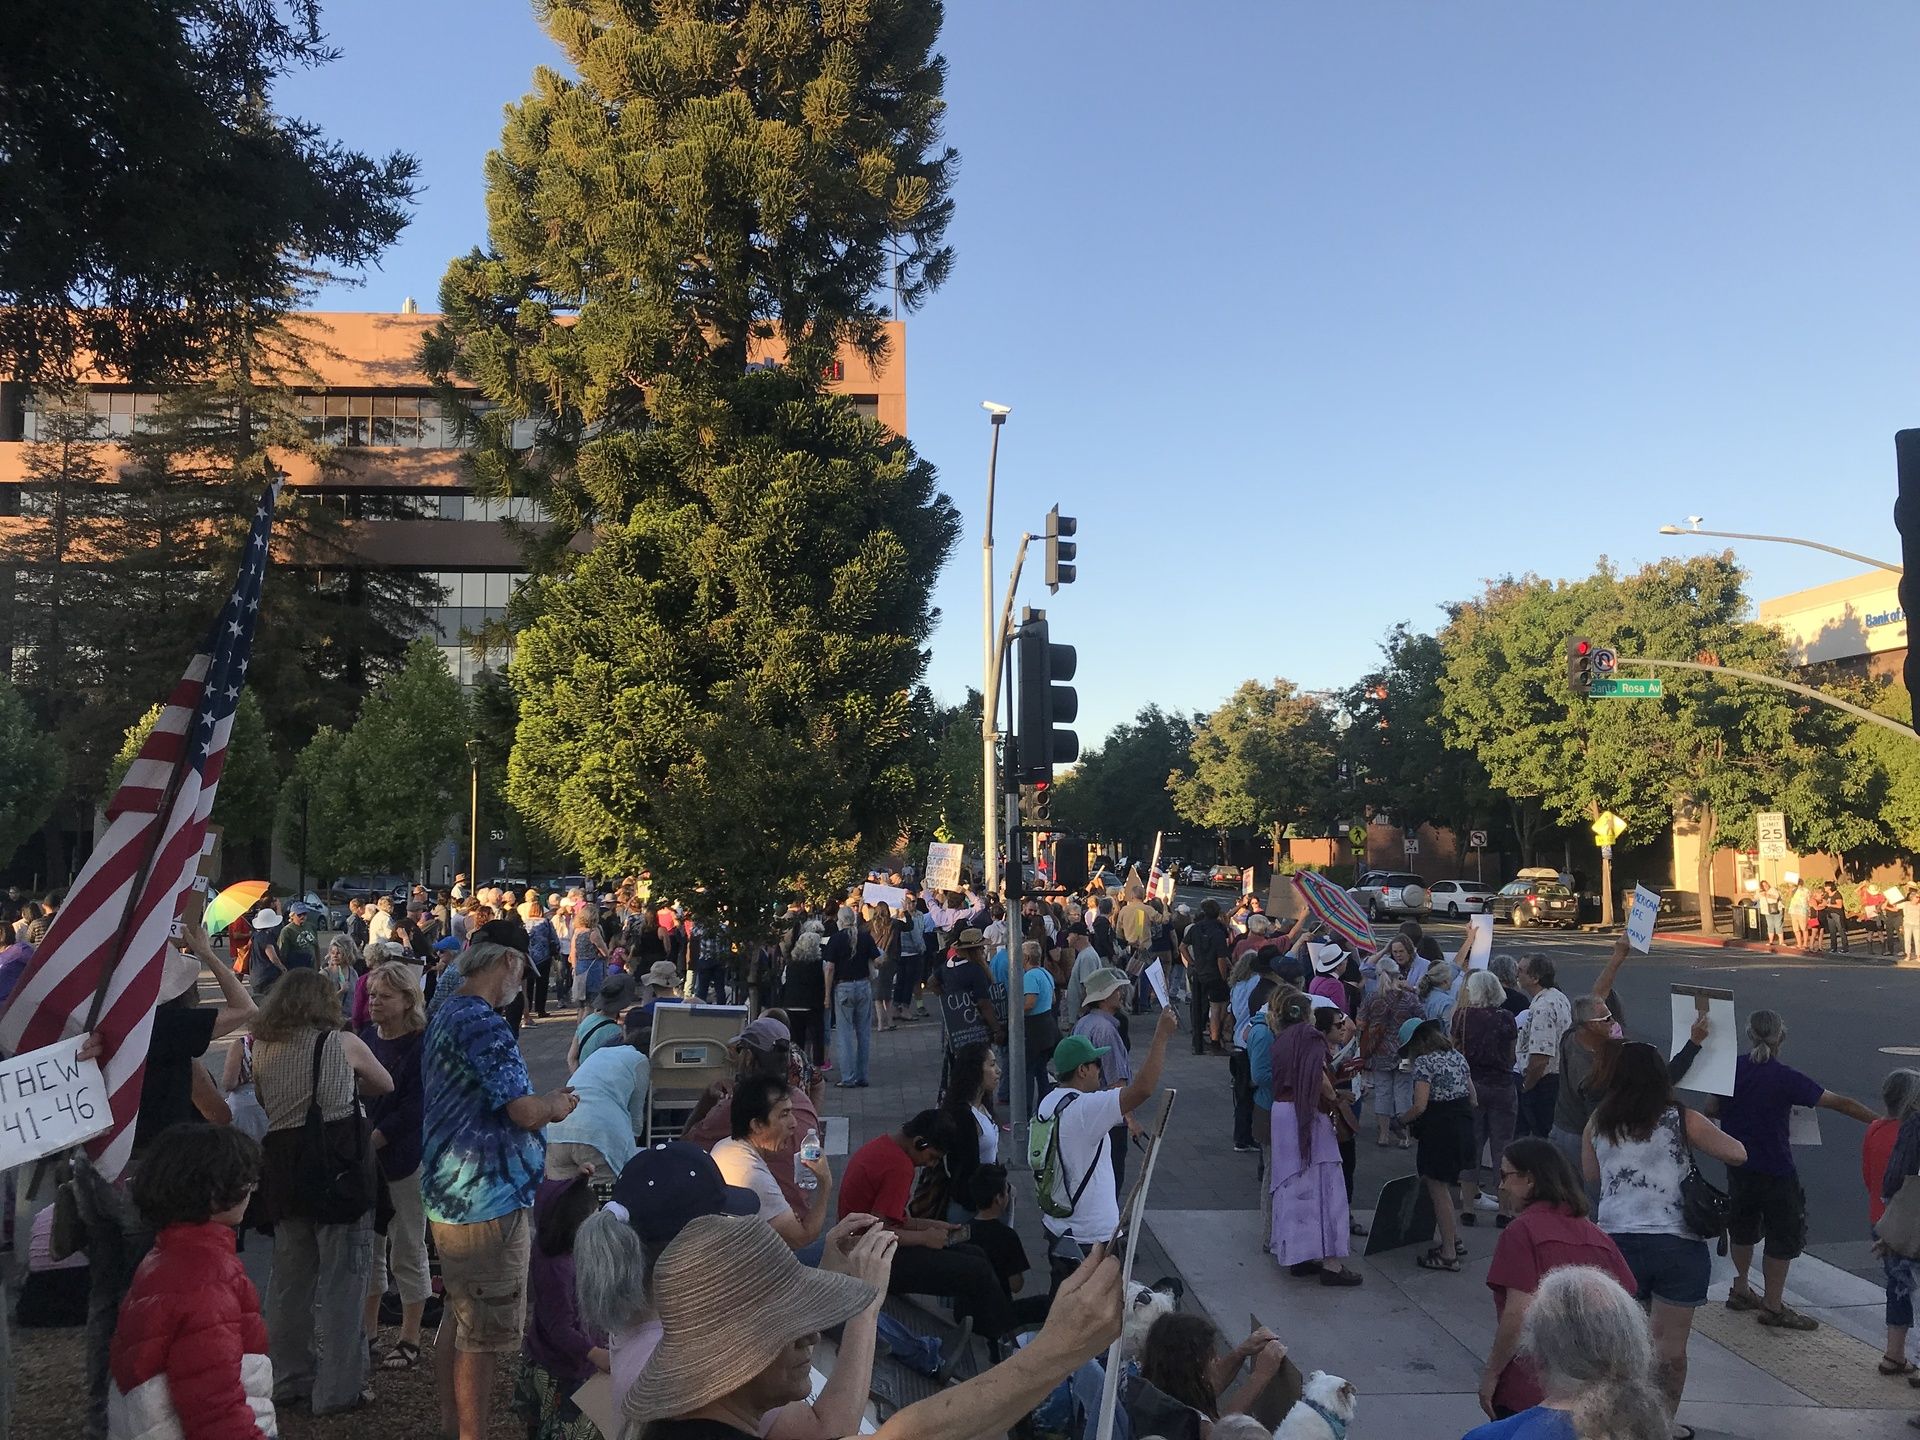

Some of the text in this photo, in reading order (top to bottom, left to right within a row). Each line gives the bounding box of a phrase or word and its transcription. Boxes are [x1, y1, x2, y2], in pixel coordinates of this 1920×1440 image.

[1865, 610, 1889, 628] Bank
[1889, 606, 1900, 622] of
[1591, 683, 1617, 694] Santa
[1622, 683, 1645, 694] Rosa
[1761, 828, 1783, 840] 25
[988, 982, 1007, 1000] THE
[0, 1048, 79, 1105] THEW
[3, 1086, 94, 1144] 41-46
